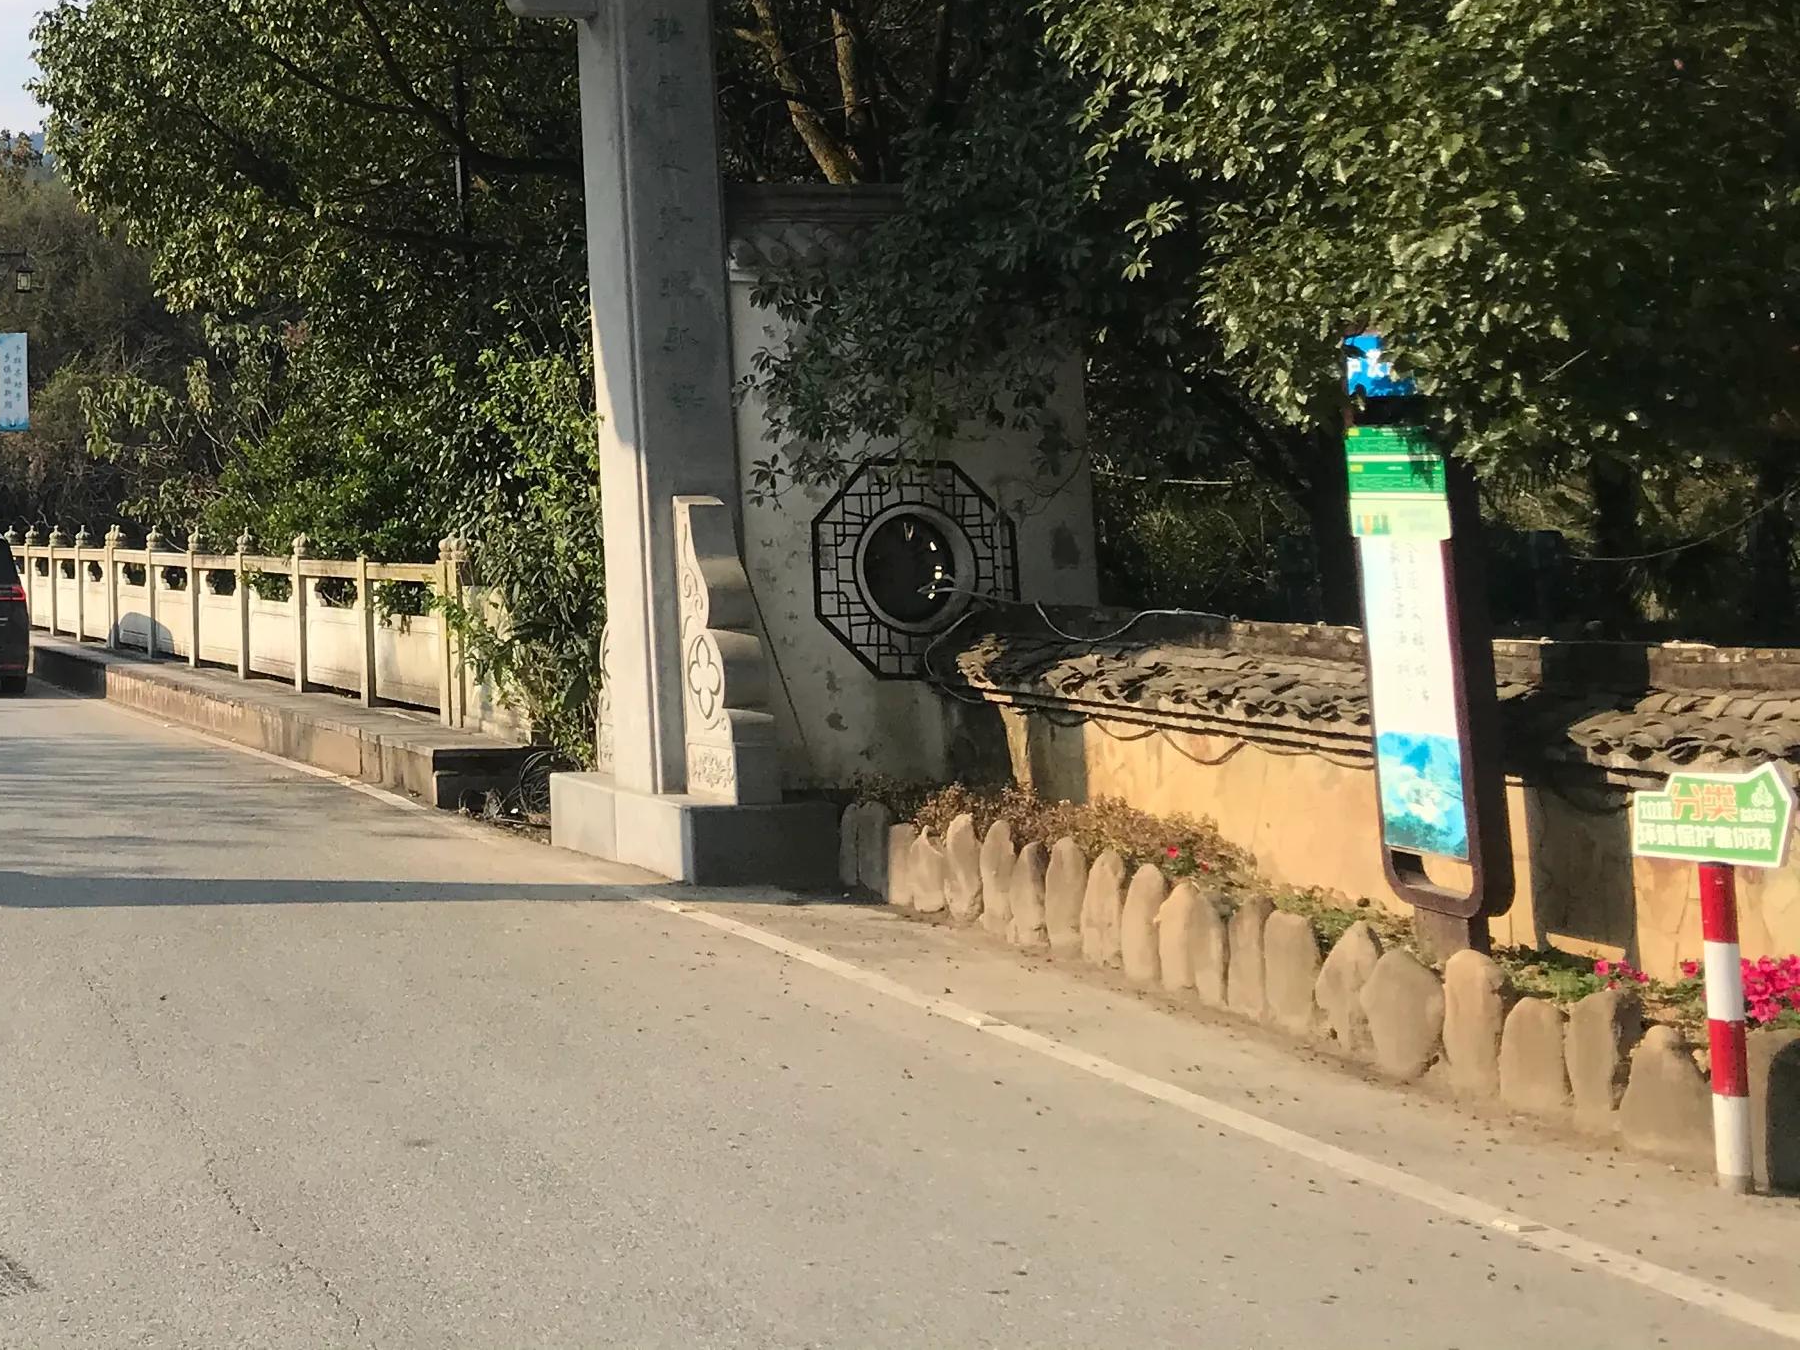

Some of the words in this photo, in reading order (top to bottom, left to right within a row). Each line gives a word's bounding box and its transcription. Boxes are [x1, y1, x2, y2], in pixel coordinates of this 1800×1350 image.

[1638, 824, 1772, 850] 环境保护靠你我
